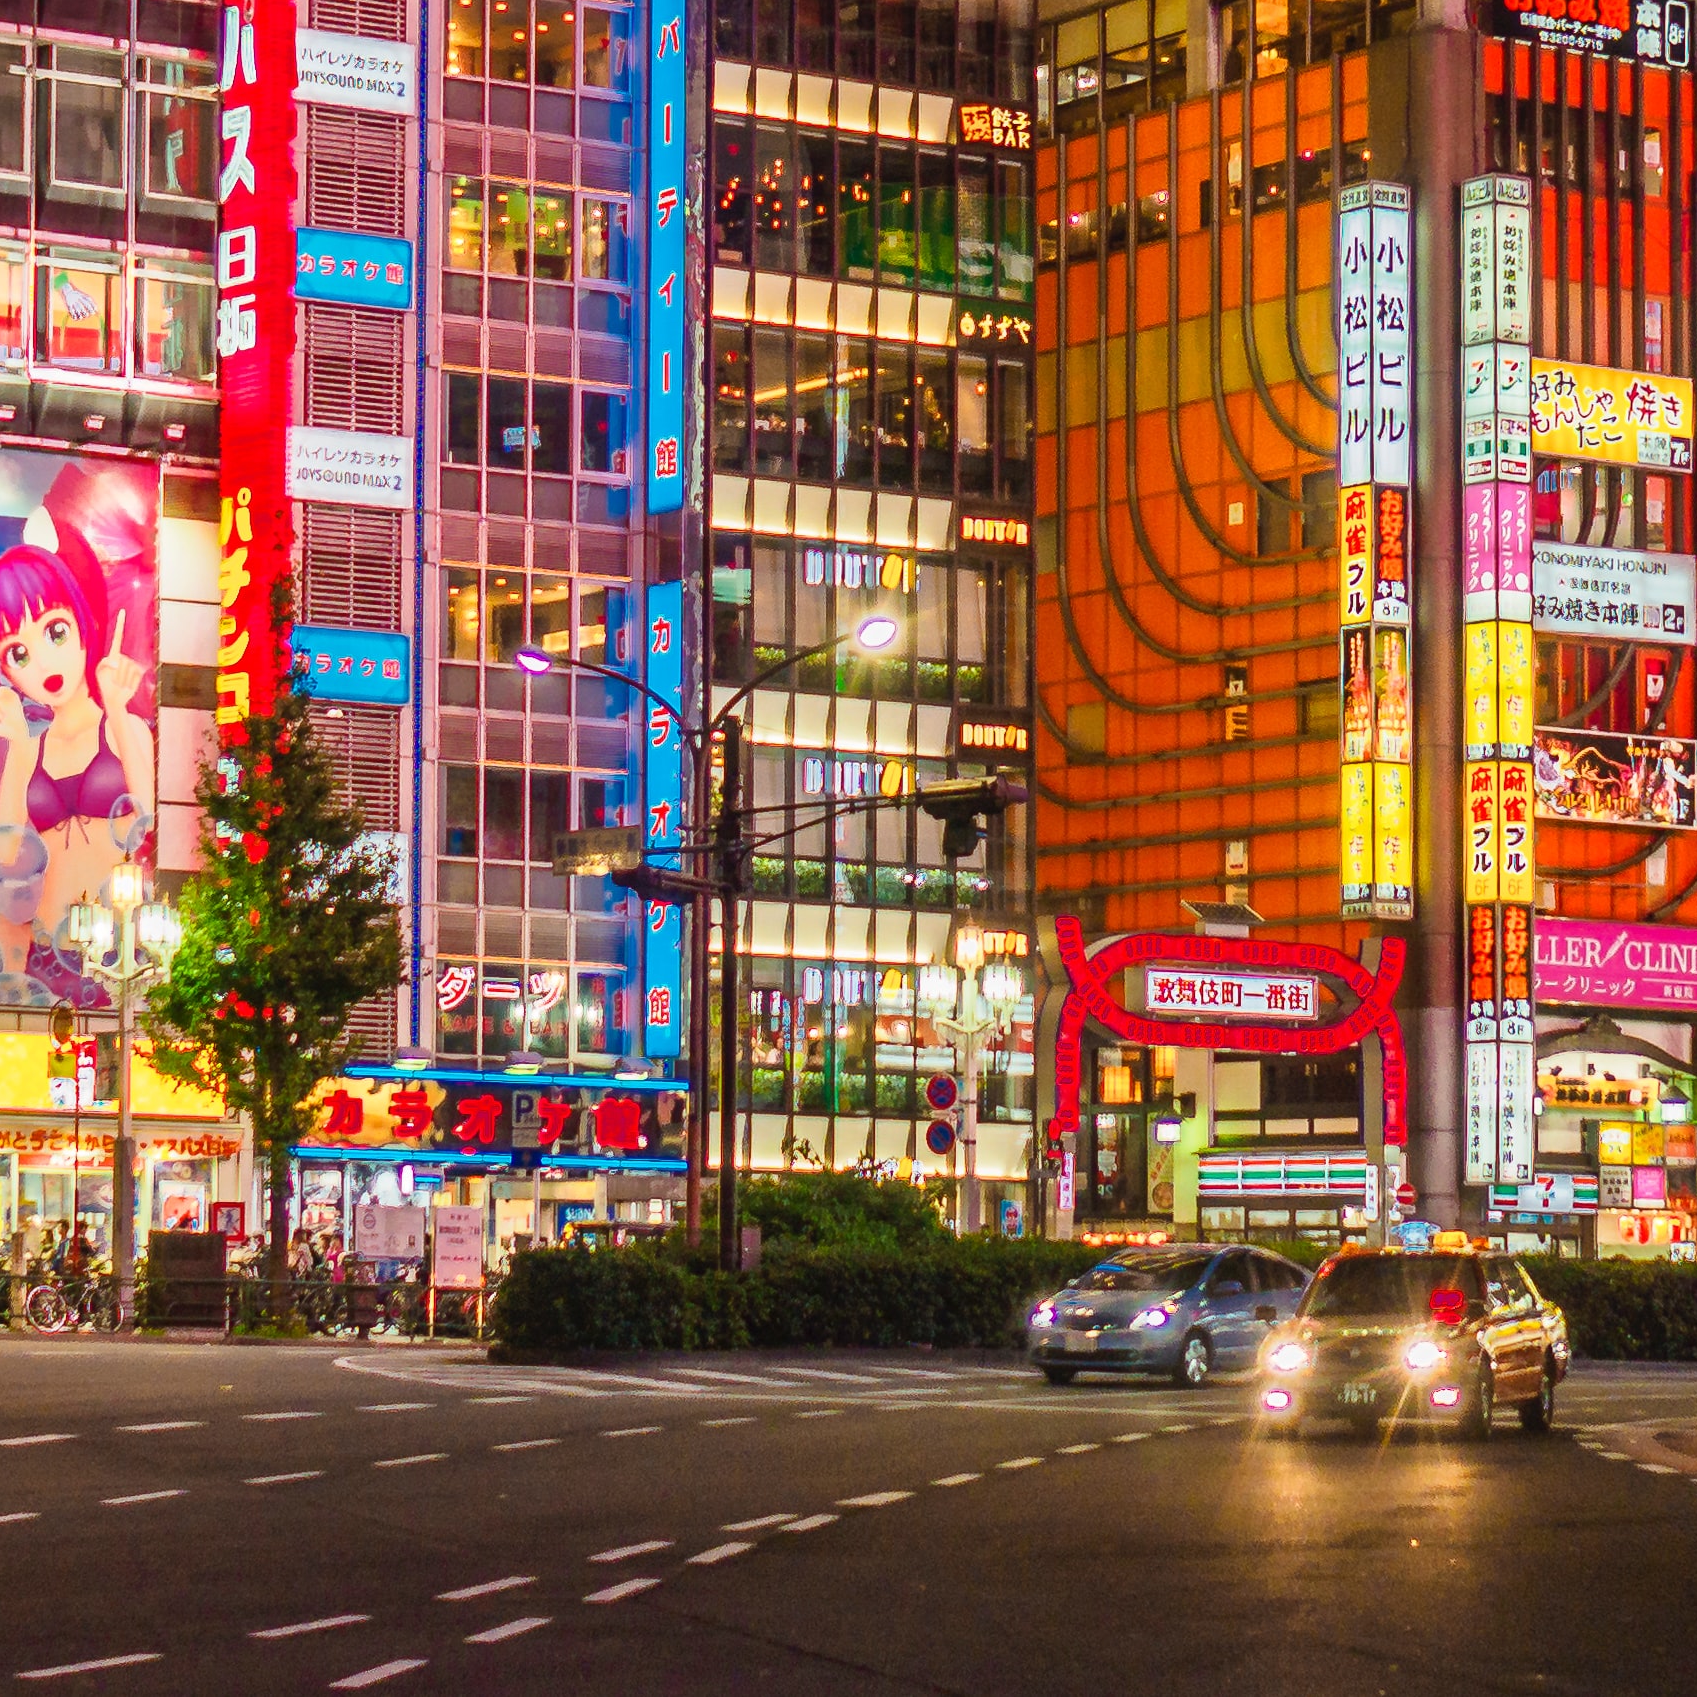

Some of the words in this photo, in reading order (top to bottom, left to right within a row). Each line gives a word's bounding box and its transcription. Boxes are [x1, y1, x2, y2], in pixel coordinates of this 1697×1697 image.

[1668, 22, 1686, 46] 8F
[302, 44, 405, 77] ハイレゾカラオケ
[299, 69, 363, 94] JOYSOUND
[991, 107, 1031, 131] 餃子
[992, 128, 1031, 149] BAR
[298, 250, 404, 286] カラオケ館
[1344, 236, 1369, 444] 小松ビル
[1376, 236, 1406, 444] 小松ビル
[295, 444, 403, 471] ハイレゾカラオケ
[1670, 441, 1691, 465] 7F
[295, 466, 359, 488] JOYSOUND
[960, 515, 1030, 546] DOUTOR
[217, 485, 253, 728] パチンコ
[1664, 607, 1685, 632] 2F
[960, 722, 1029, 751] DOUTOR
[1474, 878, 1490, 896] 6F
[1507, 878, 1524, 897] 6F
[436, 964, 566, 1011] ダーツ
[1152, 973, 1311, 1014] 歌舞伎町一番街
[1506, 1020, 1525, 1037] 8F
[322, 1089, 646, 1150] カラオケ館
[515, 1093, 534, 1123] P
